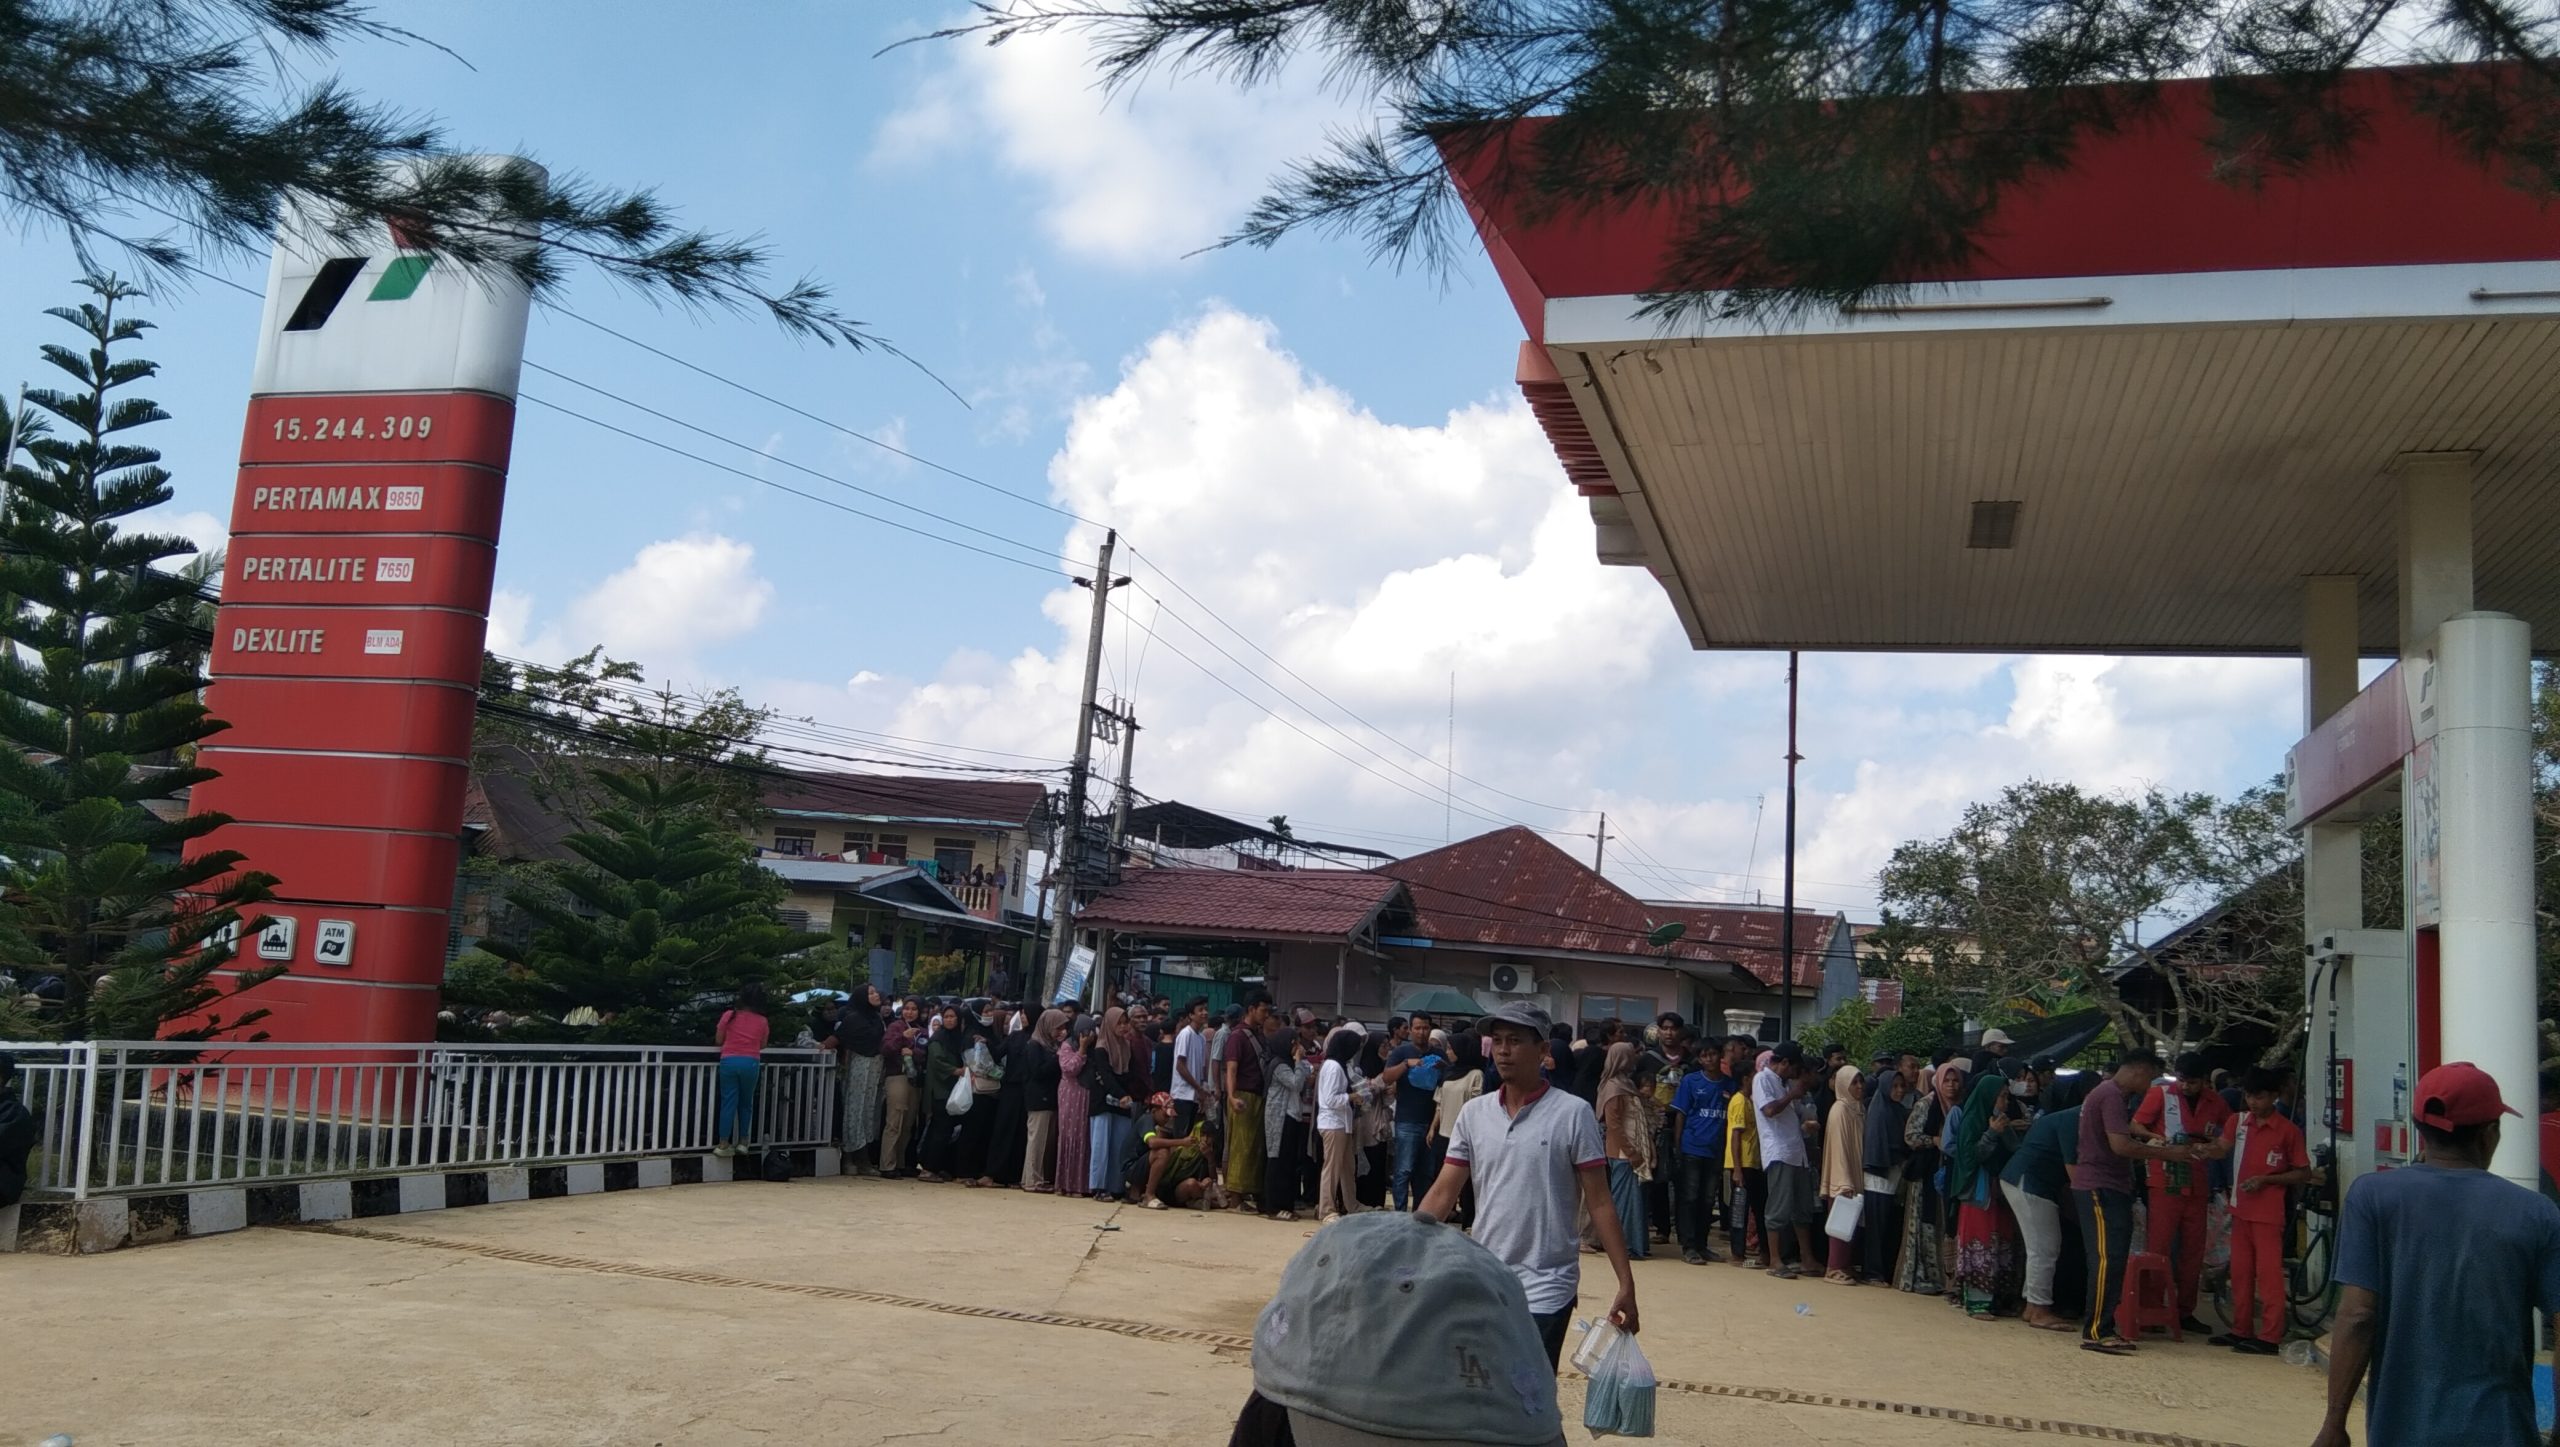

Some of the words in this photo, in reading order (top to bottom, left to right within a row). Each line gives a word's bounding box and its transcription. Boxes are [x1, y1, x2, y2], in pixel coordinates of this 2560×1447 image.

[273, 416, 433, 440] 15.244.309
[253, 486, 382, 511] PERTAMAX
[389, 491, 420, 507] 9850
[242, 557, 366, 582] PERTALITE
[380, 561, 411, 579] 7650
[232, 628, 325, 653] DEXLITE
[324, 927, 344, 938] ATM
[326, 943, 336, 952] Rp
[1455, 1345, 1493, 1390] LA
